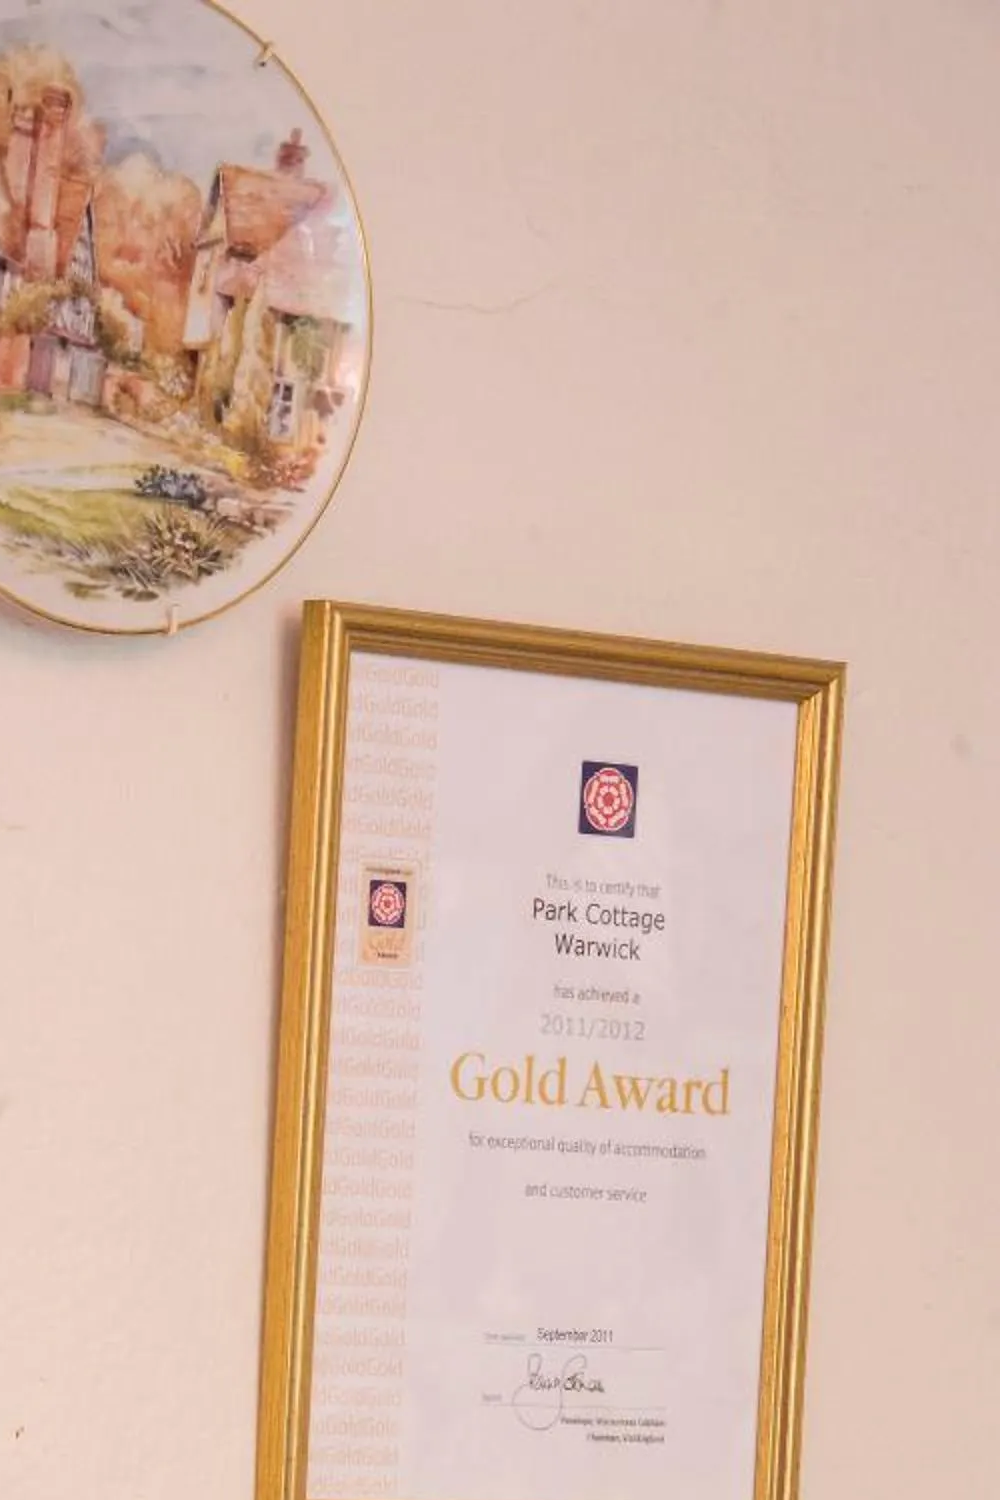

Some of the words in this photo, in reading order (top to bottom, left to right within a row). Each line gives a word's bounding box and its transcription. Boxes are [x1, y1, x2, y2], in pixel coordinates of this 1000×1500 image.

[547, 873, 568, 890] This
[574, 878, 582, 892] is
[585, 880, 597, 893] to
[600, 881, 635, 897] certify
[638, 883, 661, 899] that
[533, 897, 577, 922] Park
[586, 903, 665, 934] Cottage
[555, 933, 641, 961] Warwick
[553, 984, 574, 999] has
[577, 986, 630, 1004] achieved
[632, 993, 640, 1005] a
[539, 1013, 646, 1041] 2011/2012
[449, 1051, 567, 1107] Gold
[580, 1061, 730, 1115] Award
[468, 1130, 485, 1147] for
[487, 1134, 554, 1153] exceptional
[557, 1137, 596, 1156] quality
[600, 1138, 612, 1155] of
[613, 1142, 706, 1160] accommodation
[525, 1182, 547, 1198] and
[550, 1184, 603, 1200] customer
[606, 1186, 647, 1202] service
[537, 1328, 588, 1343] September
[591, 1329, 613, 1344] 2011
